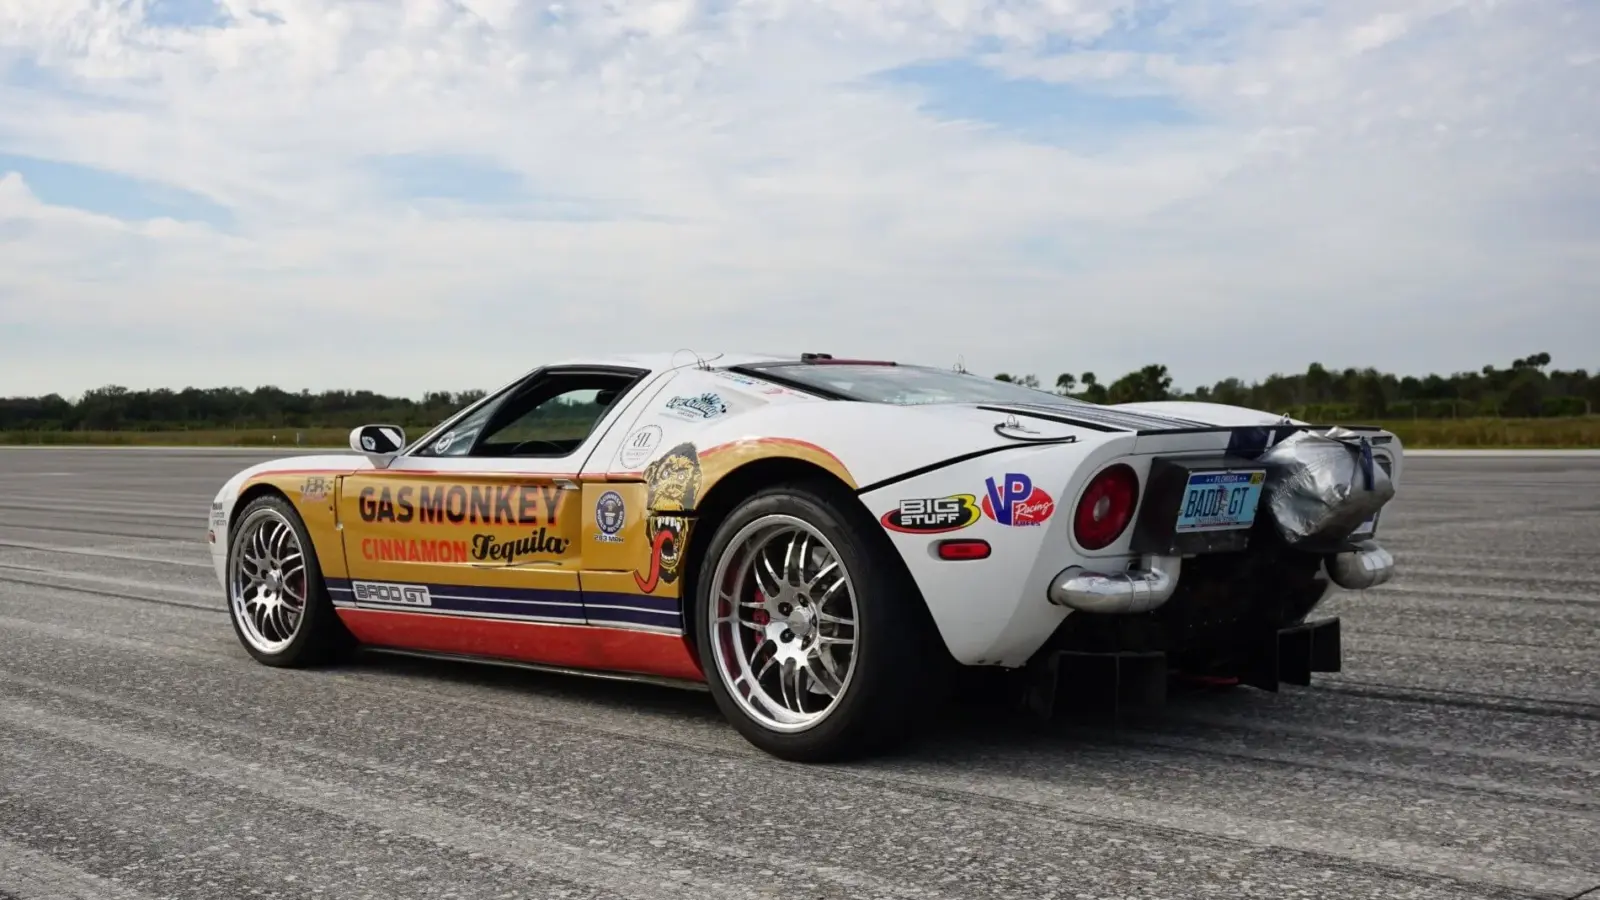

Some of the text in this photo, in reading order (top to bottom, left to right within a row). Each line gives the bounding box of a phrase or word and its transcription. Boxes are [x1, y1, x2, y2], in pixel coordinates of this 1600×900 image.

[359, 485, 567, 526] GAS MONKEY
[900, 499, 960, 514] BIG
[985, 473, 1032, 526] VP
[1015, 500, 1054, 520] Racing
[1184, 486, 1250, 518] BADD GT
[901, 513, 960, 526] STUFF
[361, 527, 568, 563] CINNAMON Tequila
[404, 587, 427, 603] GT
